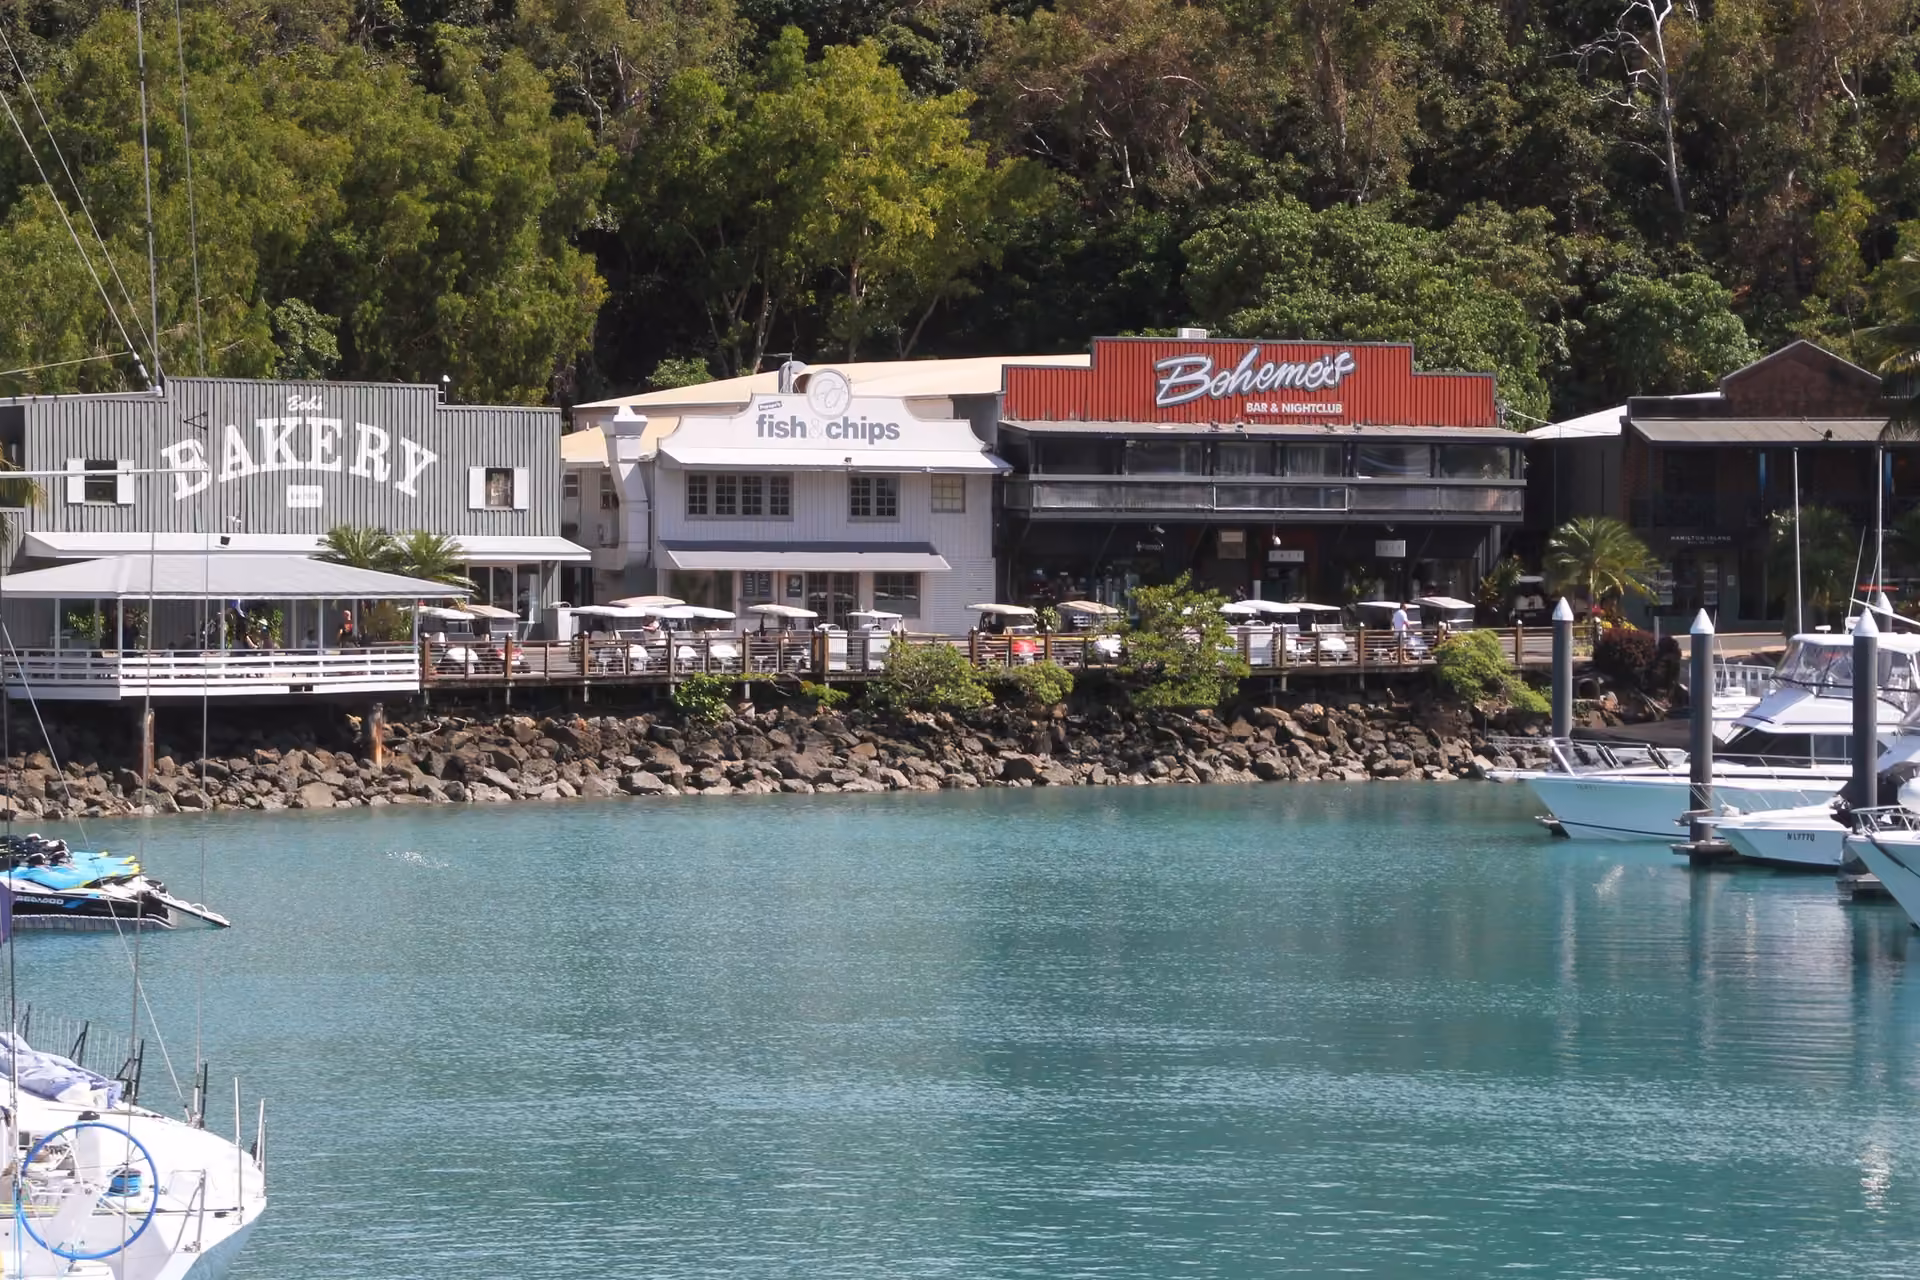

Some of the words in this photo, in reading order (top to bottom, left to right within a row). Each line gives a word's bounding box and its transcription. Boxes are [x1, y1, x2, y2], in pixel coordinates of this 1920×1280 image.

[1246, 402, 1268, 413] BAR
[1269, 402, 1279, 413] &
[1281, 402, 1343, 413] NIGHTCLUB
[756, 414, 807, 439] fish
[825, 415, 901, 445] chips
[161, 416, 438, 501] BAKERY
